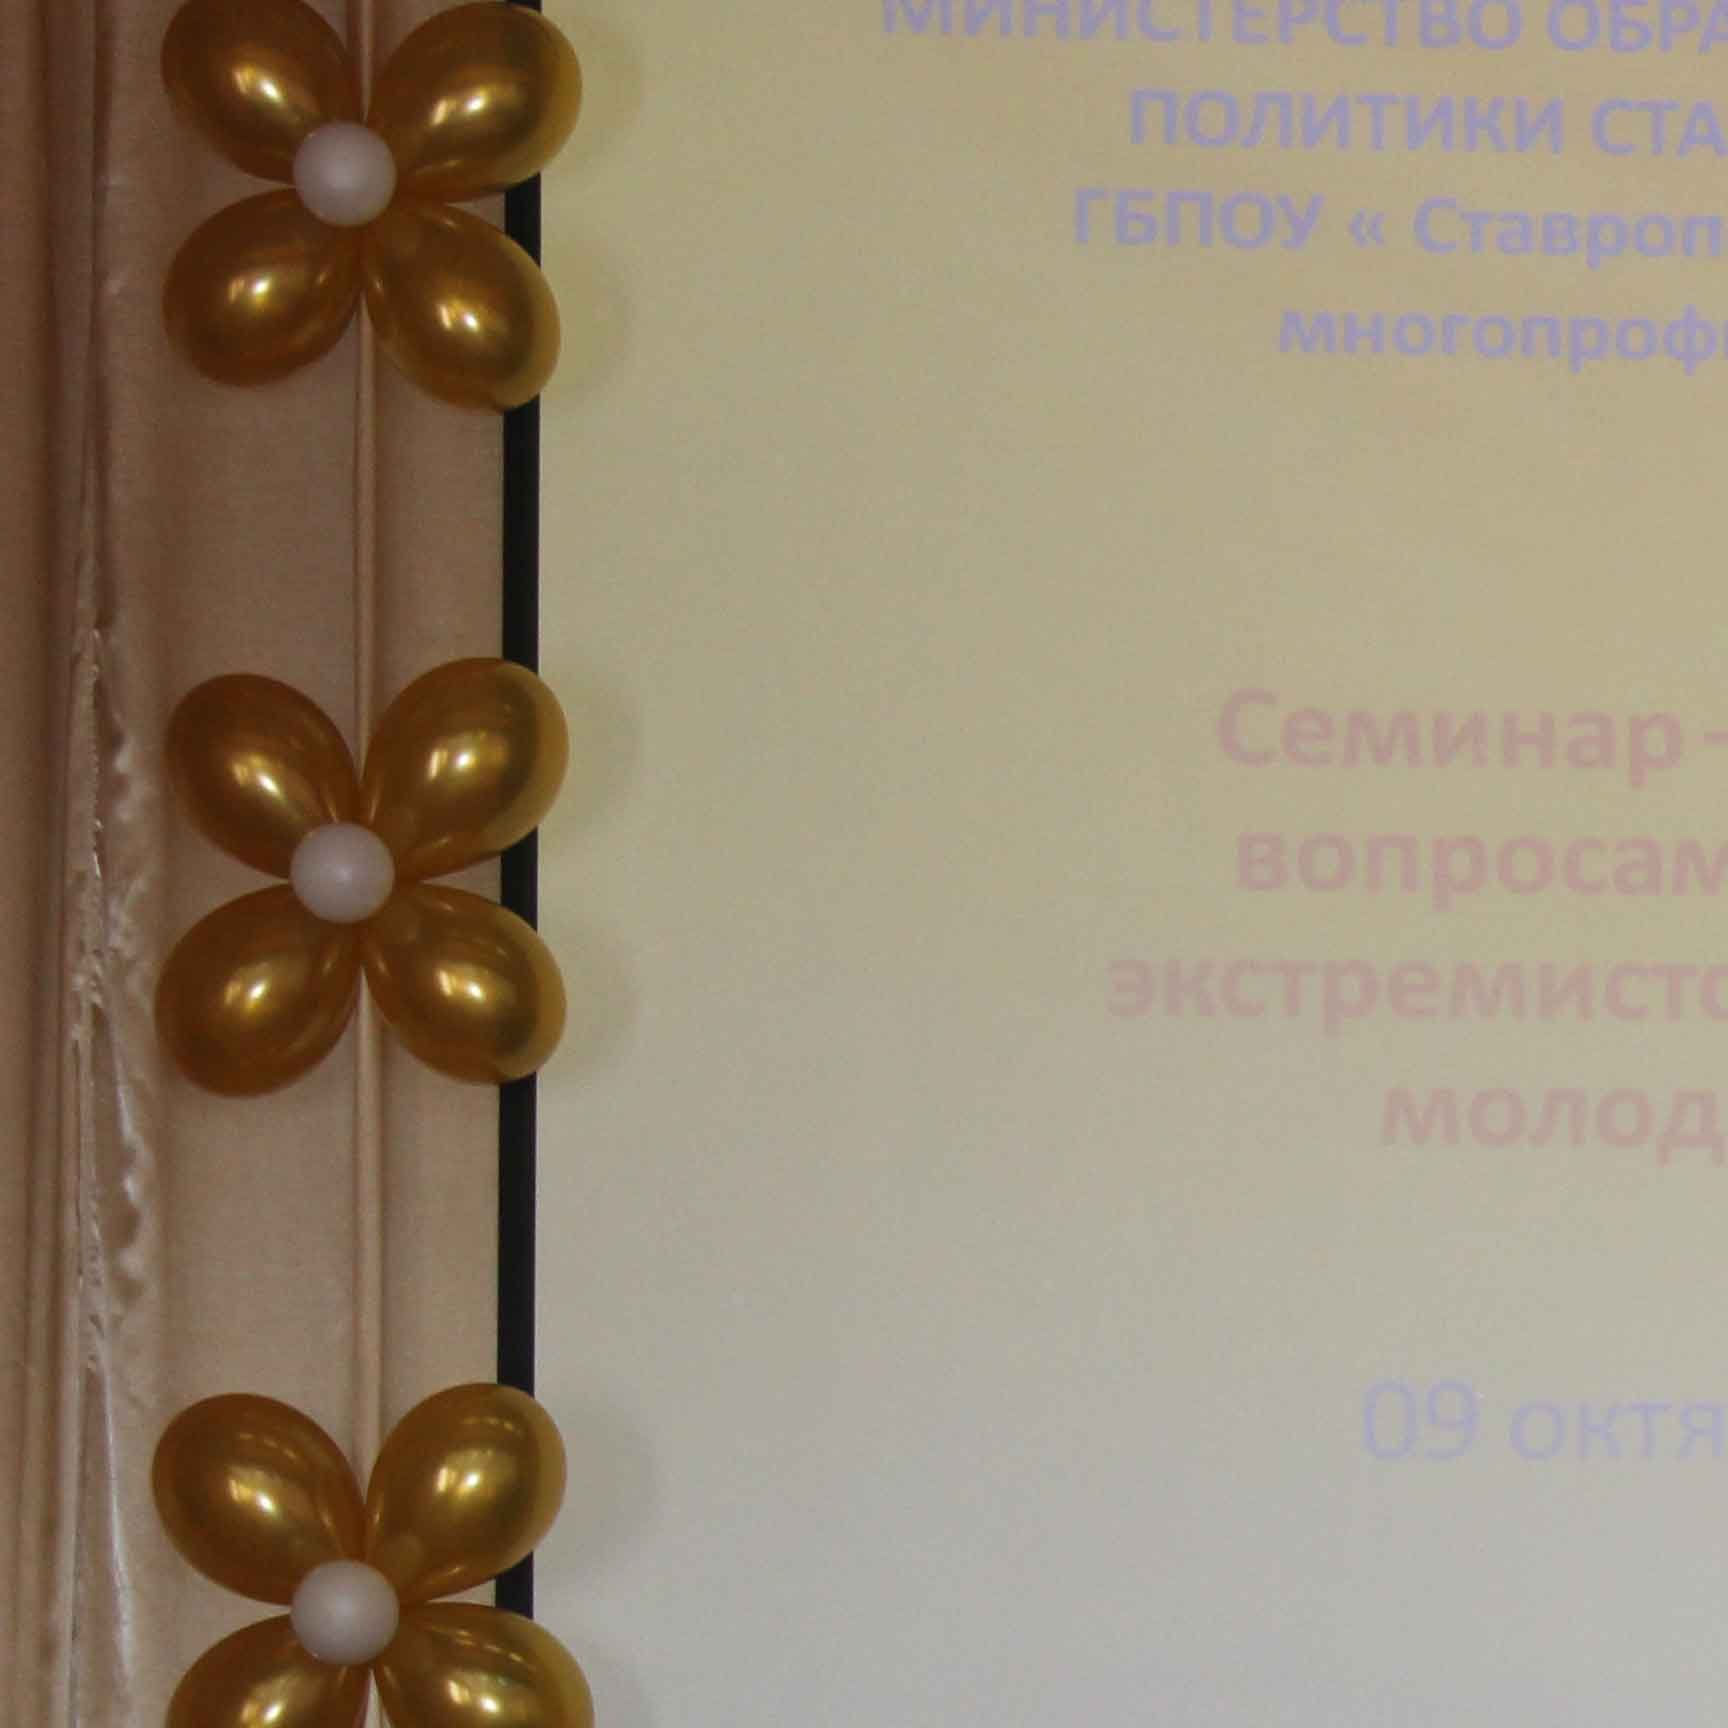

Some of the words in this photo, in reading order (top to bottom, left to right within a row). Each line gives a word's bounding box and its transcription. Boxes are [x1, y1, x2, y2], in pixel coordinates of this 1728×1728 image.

[882, 0, 1521, 49] МИНИСТЕРСТВО
[1130, 88, 1563, 151] ПОЛИТИКИ
[1074, 187, 1325, 252] ГБПОУ
[1215, 687, 1684, 789] Семинар
[1362, 1379, 1482, 1460] 09
